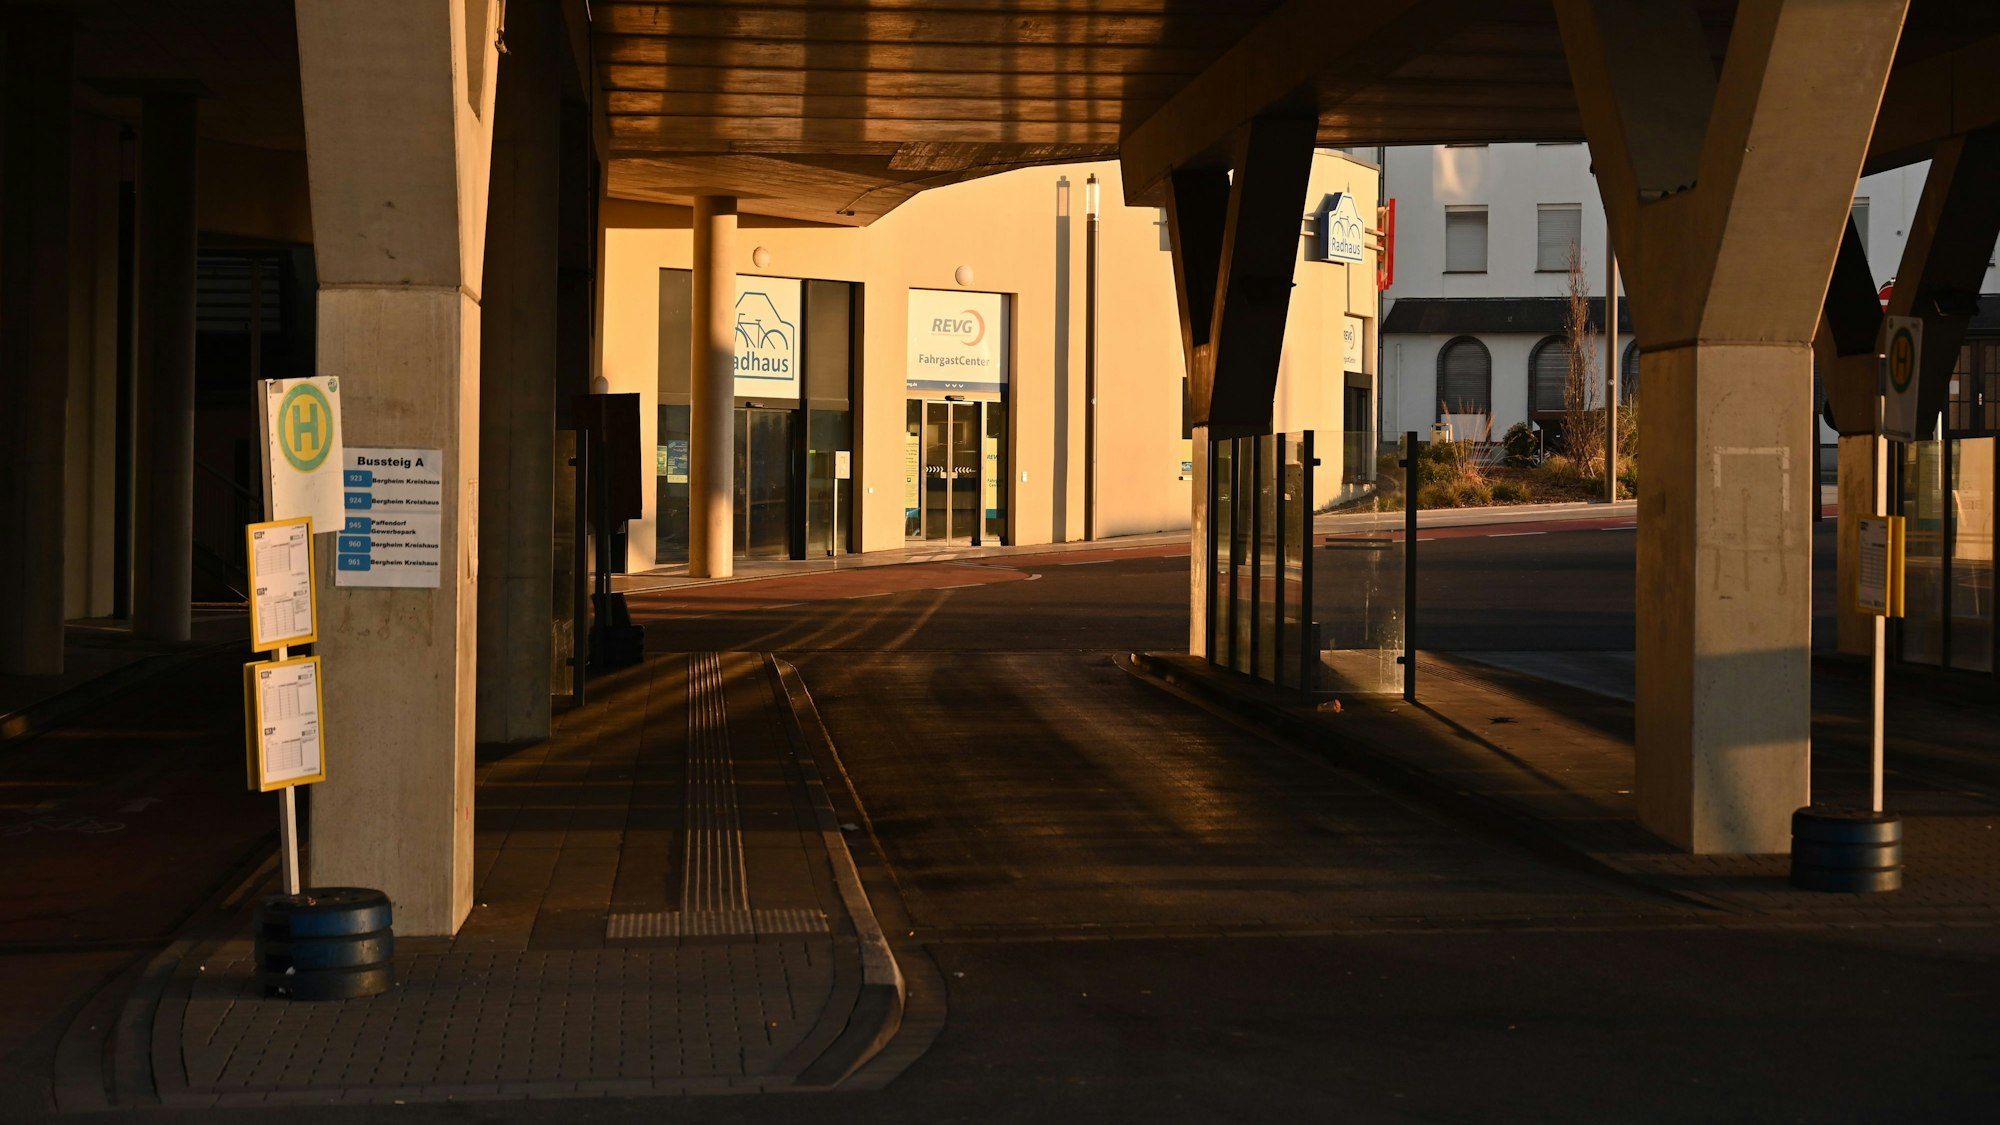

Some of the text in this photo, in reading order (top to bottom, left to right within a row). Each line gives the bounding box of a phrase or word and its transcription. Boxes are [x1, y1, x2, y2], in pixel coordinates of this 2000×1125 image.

[1332, 237, 1360, 255] Radhaus
[931, 318, 973, 334] REVG
[734, 350, 789, 373] adhaus
[918, 354, 990, 367] FahrgastCenter
[292, 403, 319, 452] H
[357, 456, 424, 468] Bussteig A
[370, 559, 403, 567] Bergheim
